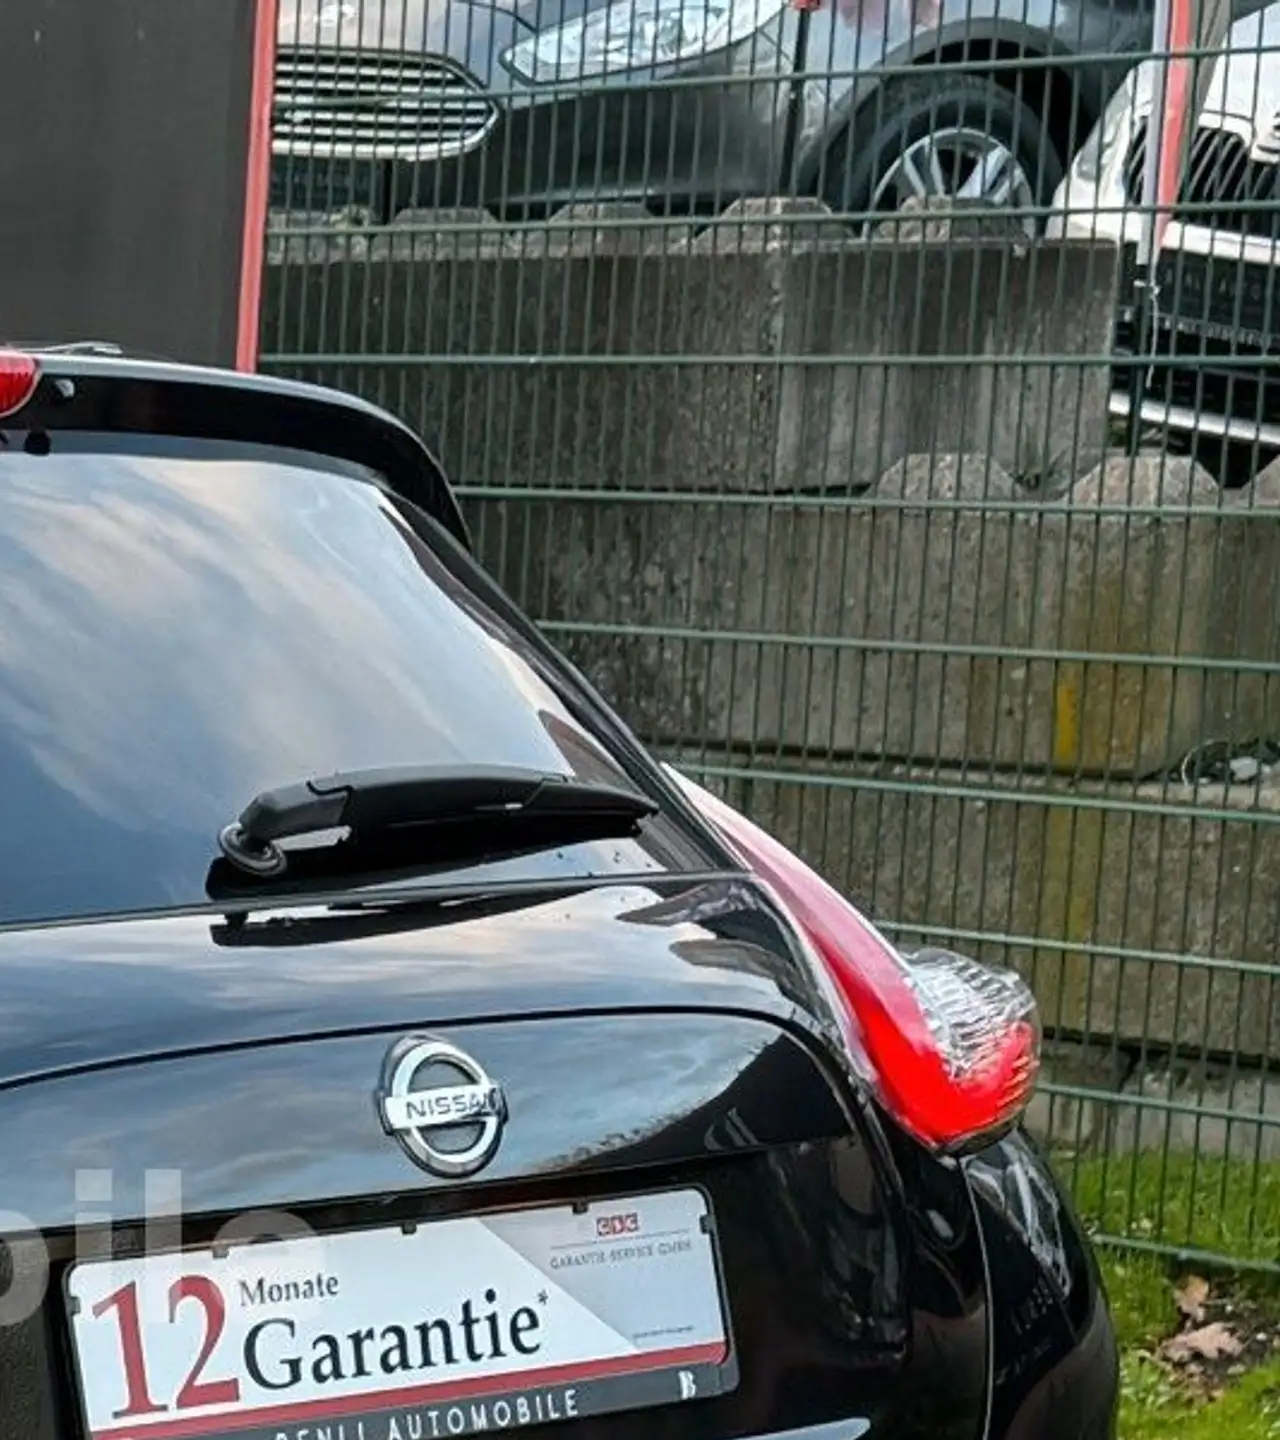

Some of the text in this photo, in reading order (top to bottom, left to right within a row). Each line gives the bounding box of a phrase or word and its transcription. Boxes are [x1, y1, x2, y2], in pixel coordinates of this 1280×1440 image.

[405, 1088, 497, 1119] NISSAN
[239, 1271, 339, 1308] Monate
[92, 1274, 241, 1419] 12
